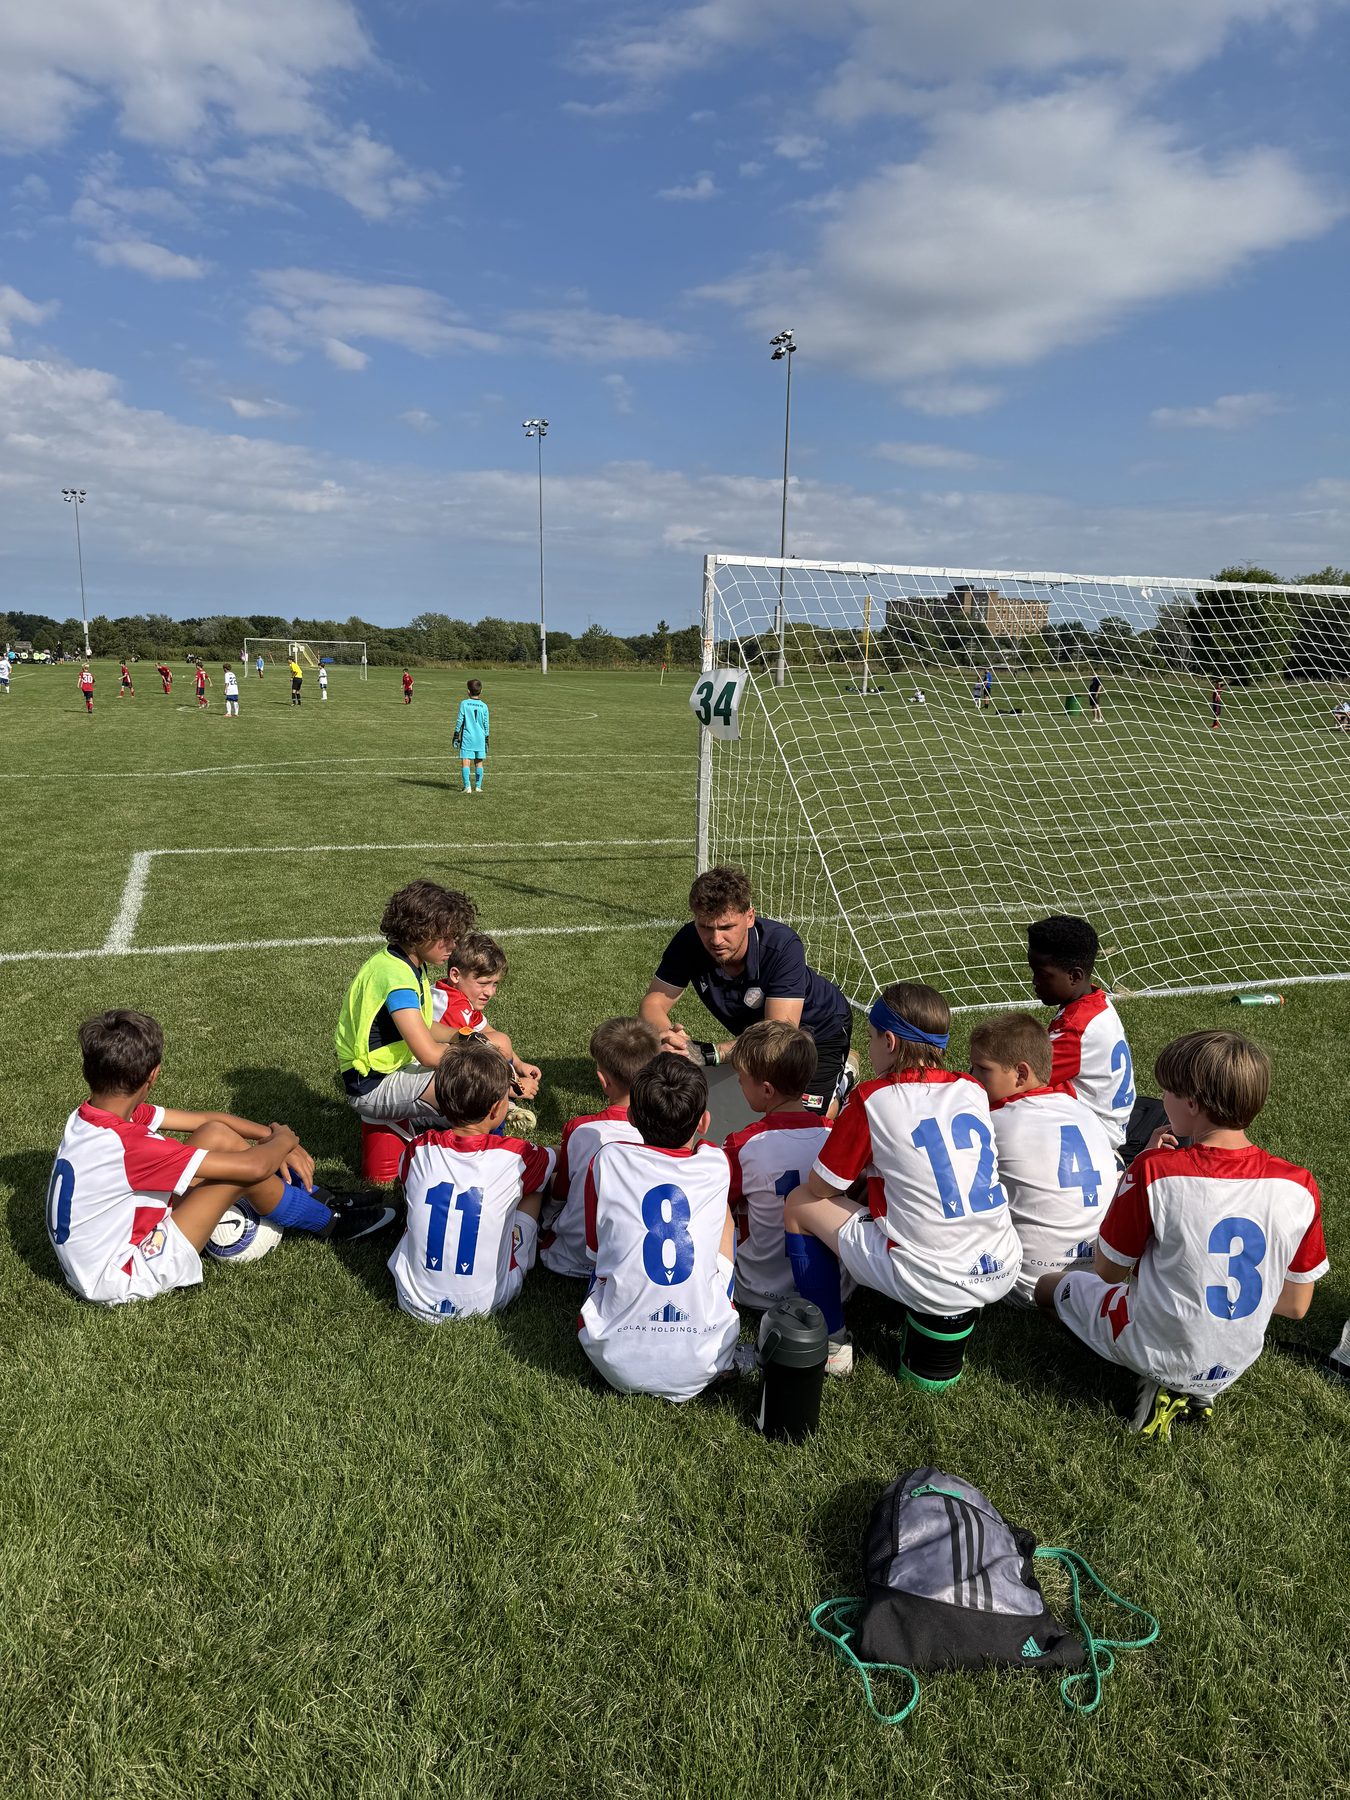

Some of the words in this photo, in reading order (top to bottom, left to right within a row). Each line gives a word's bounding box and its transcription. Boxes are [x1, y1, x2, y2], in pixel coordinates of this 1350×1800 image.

[82, 674, 93, 684] 30
[695, 681, 737, 726] 34
[1111, 1040, 1134, 1111] 2
[911, 1112, 1007, 1219] 12
[1058, 1125, 1102, 1207] 4
[425, 1181, 485, 1276] 11
[641, 1183, 695, 1286] 8
[1030, 1259, 1061, 1267] COLAK
[1206, 1217, 1267, 1320] 3
[617, 1325, 647, 1333] COLAK
